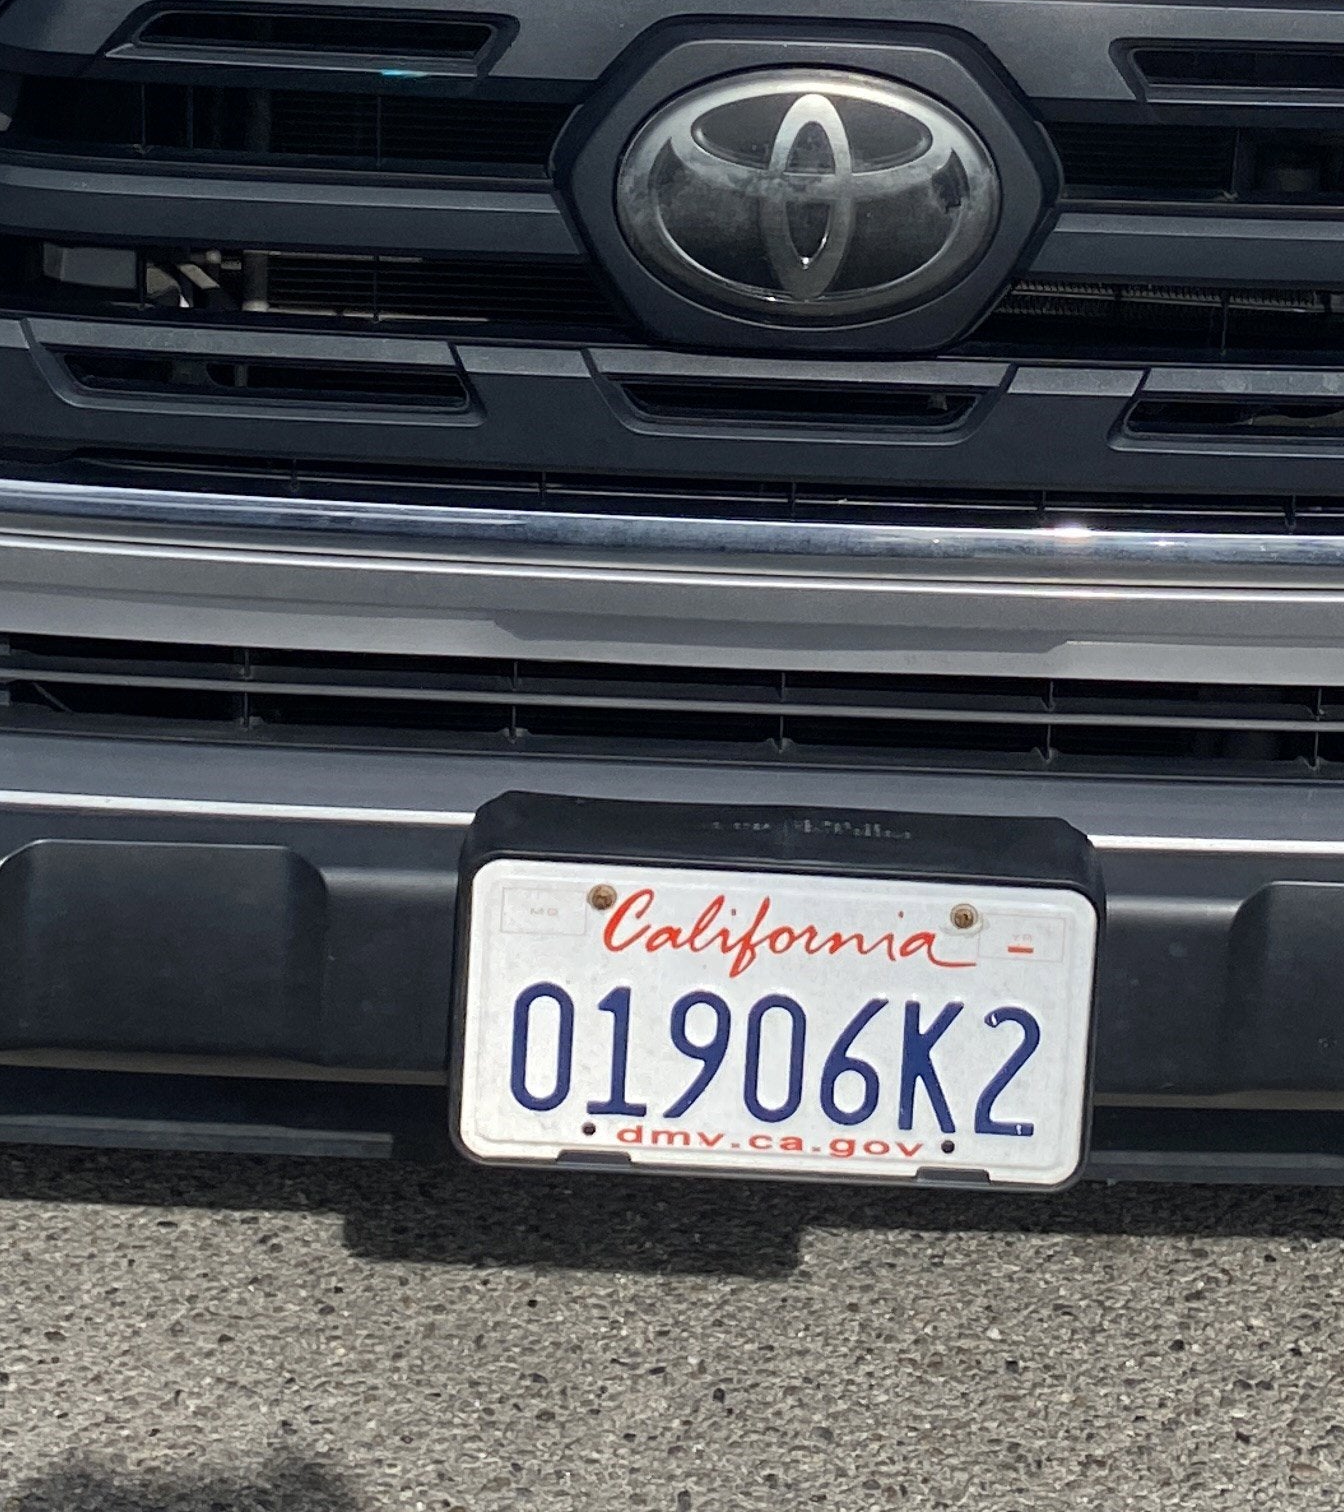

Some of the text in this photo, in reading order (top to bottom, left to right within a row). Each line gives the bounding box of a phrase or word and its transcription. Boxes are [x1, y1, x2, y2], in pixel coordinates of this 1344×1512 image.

[602, 889, 977, 978] California
[509, 981, 1042, 1138] 01906K2
[616, 1124, 924, 1160] dmv.ca.gov
